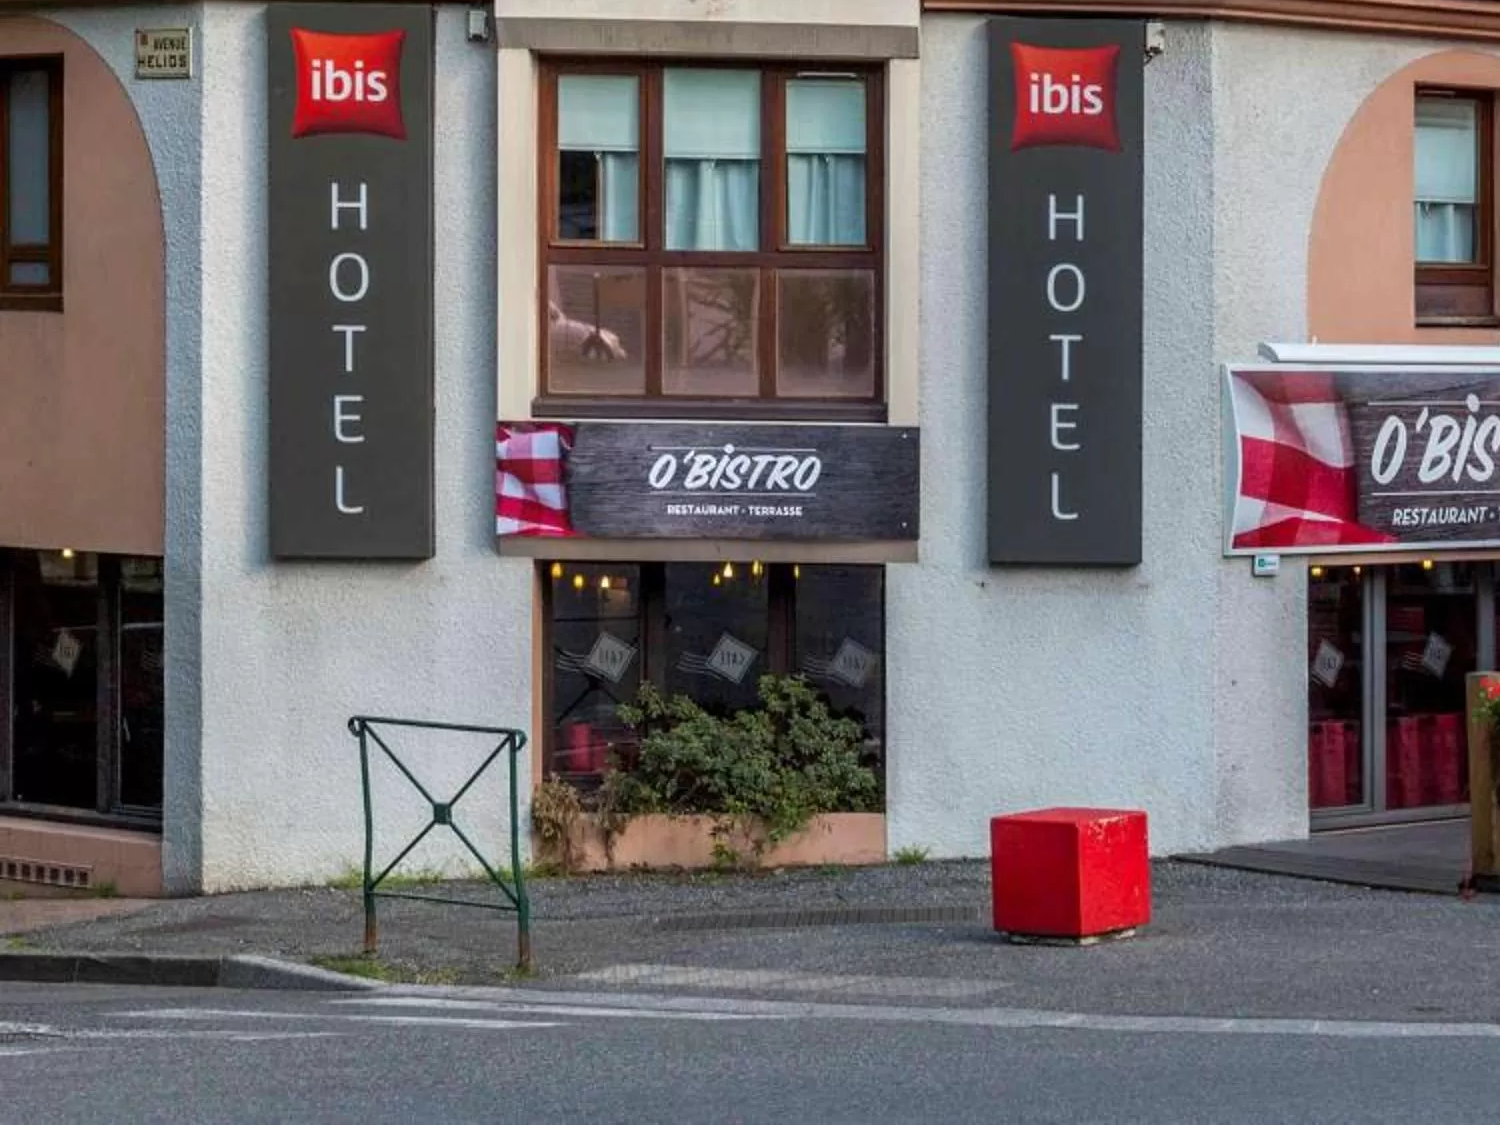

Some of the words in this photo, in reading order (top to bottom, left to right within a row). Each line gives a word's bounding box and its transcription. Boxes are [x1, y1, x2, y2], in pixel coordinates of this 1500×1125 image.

[138, 54, 187, 68] HELIOS
[153, 37, 187, 51] AVENUE
[310, 59, 389, 104] ibis
[1029, 72, 1104, 116] ibis
[329, 181, 370, 514] HOTEL
[1045, 194, 1086, 521] HOTEL
[649, 443, 822, 491] O'BISTRO
[666, 504, 741, 516] RESTAURANT
[748, 506, 803, 517] TERRASSE
[1393, 505, 1488, 526] RESTAURANT
